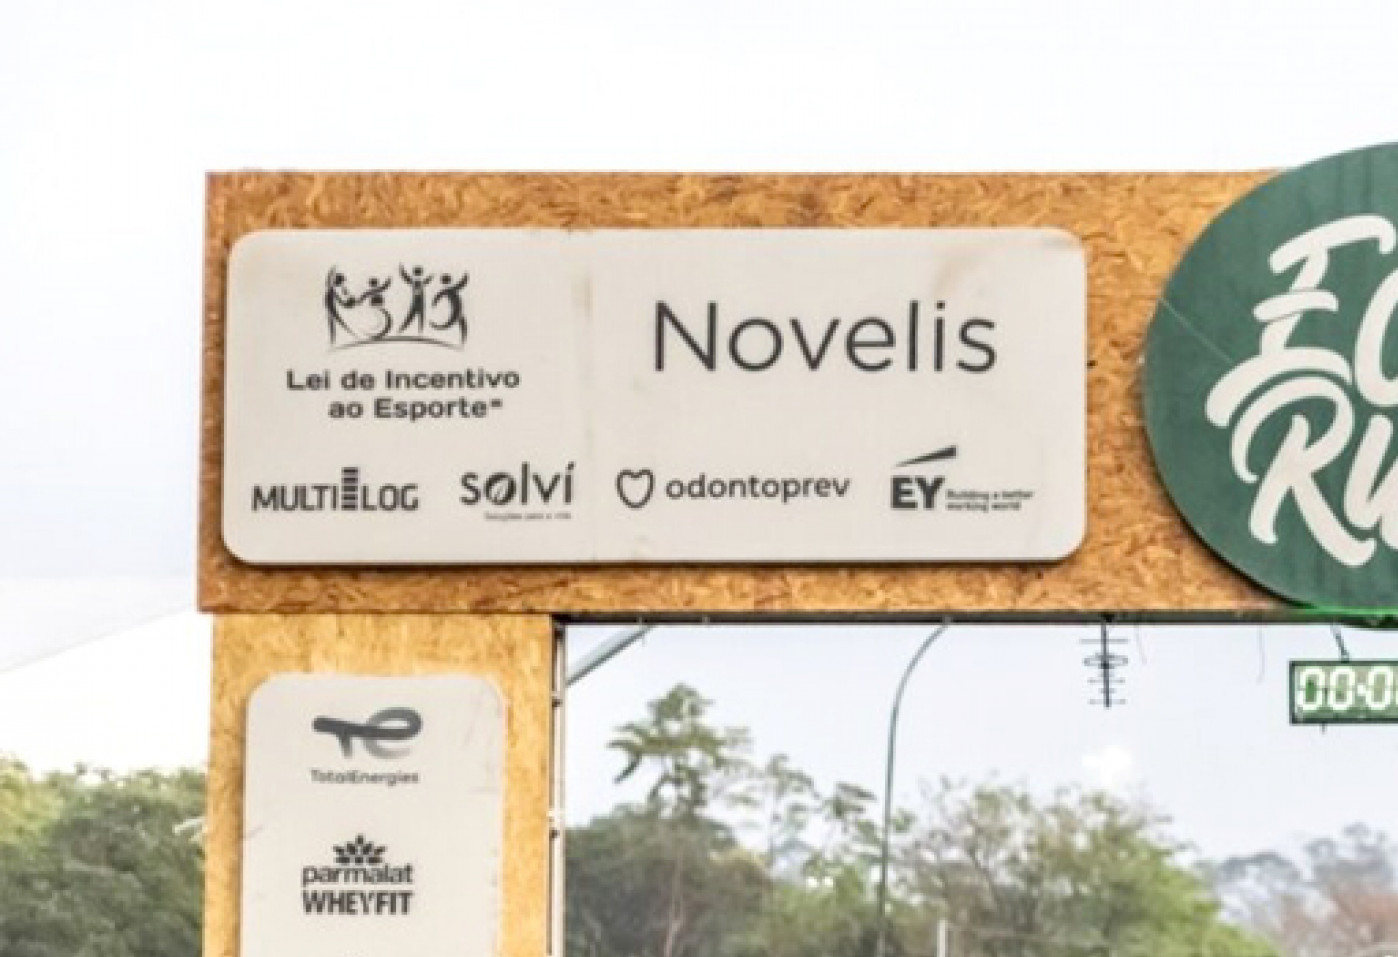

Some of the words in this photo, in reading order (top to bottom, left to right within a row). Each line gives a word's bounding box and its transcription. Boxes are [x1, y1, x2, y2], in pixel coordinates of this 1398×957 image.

[654, 299, 998, 374] Novelis
[287, 369, 330, 390] Lei
[341, 369, 375, 390] de
[385, 369, 520, 390] Incentivo
[328, 401, 364, 418] ao
[665, 473, 850, 503] odontoprev
[891, 475, 945, 510] EY
[311, 769, 419, 787] TotalEnergies
[303, 863, 413, 887] parmalat
